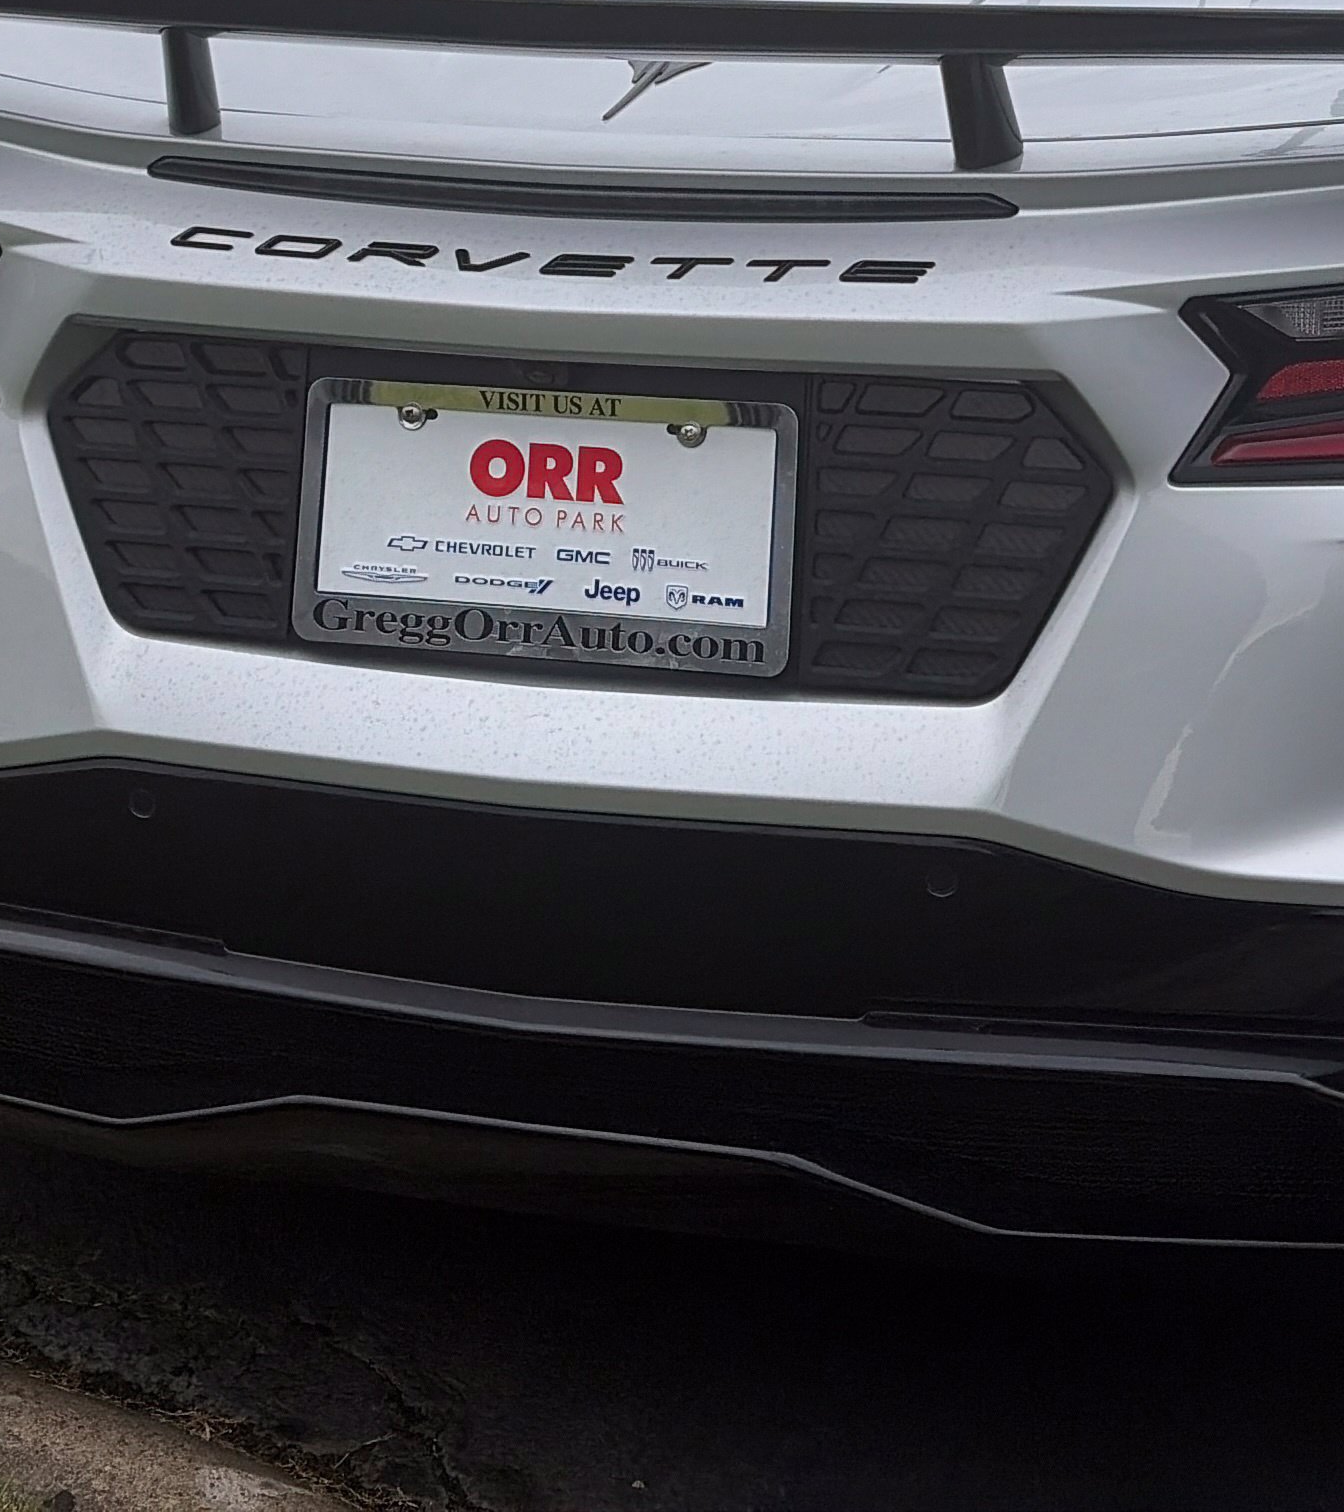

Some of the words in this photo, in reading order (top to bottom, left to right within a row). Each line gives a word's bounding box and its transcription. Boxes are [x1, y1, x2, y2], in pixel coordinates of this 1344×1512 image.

[170, 225, 937, 285] CORVETTE
[478, 390, 544, 414] VISIT
[553, 393, 583, 416] US
[588, 396, 622, 418] AT
[469, 439, 626, 506] ORR
[465, 503, 543, 528] AUTO
[557, 508, 626, 533] PARK
[435, 540, 537, 560] CHEVROLET
[556, 548, 611, 565] GMC
[656, 558, 709, 571] BUICK
[352, 564, 418, 574] CHRYSLER
[454, 574, 540, 589] DODGE
[584, 579, 641, 606] Jeep
[691, 594, 745, 608] RAM
[313, 597, 766, 665] GreggOrrAuto.com
